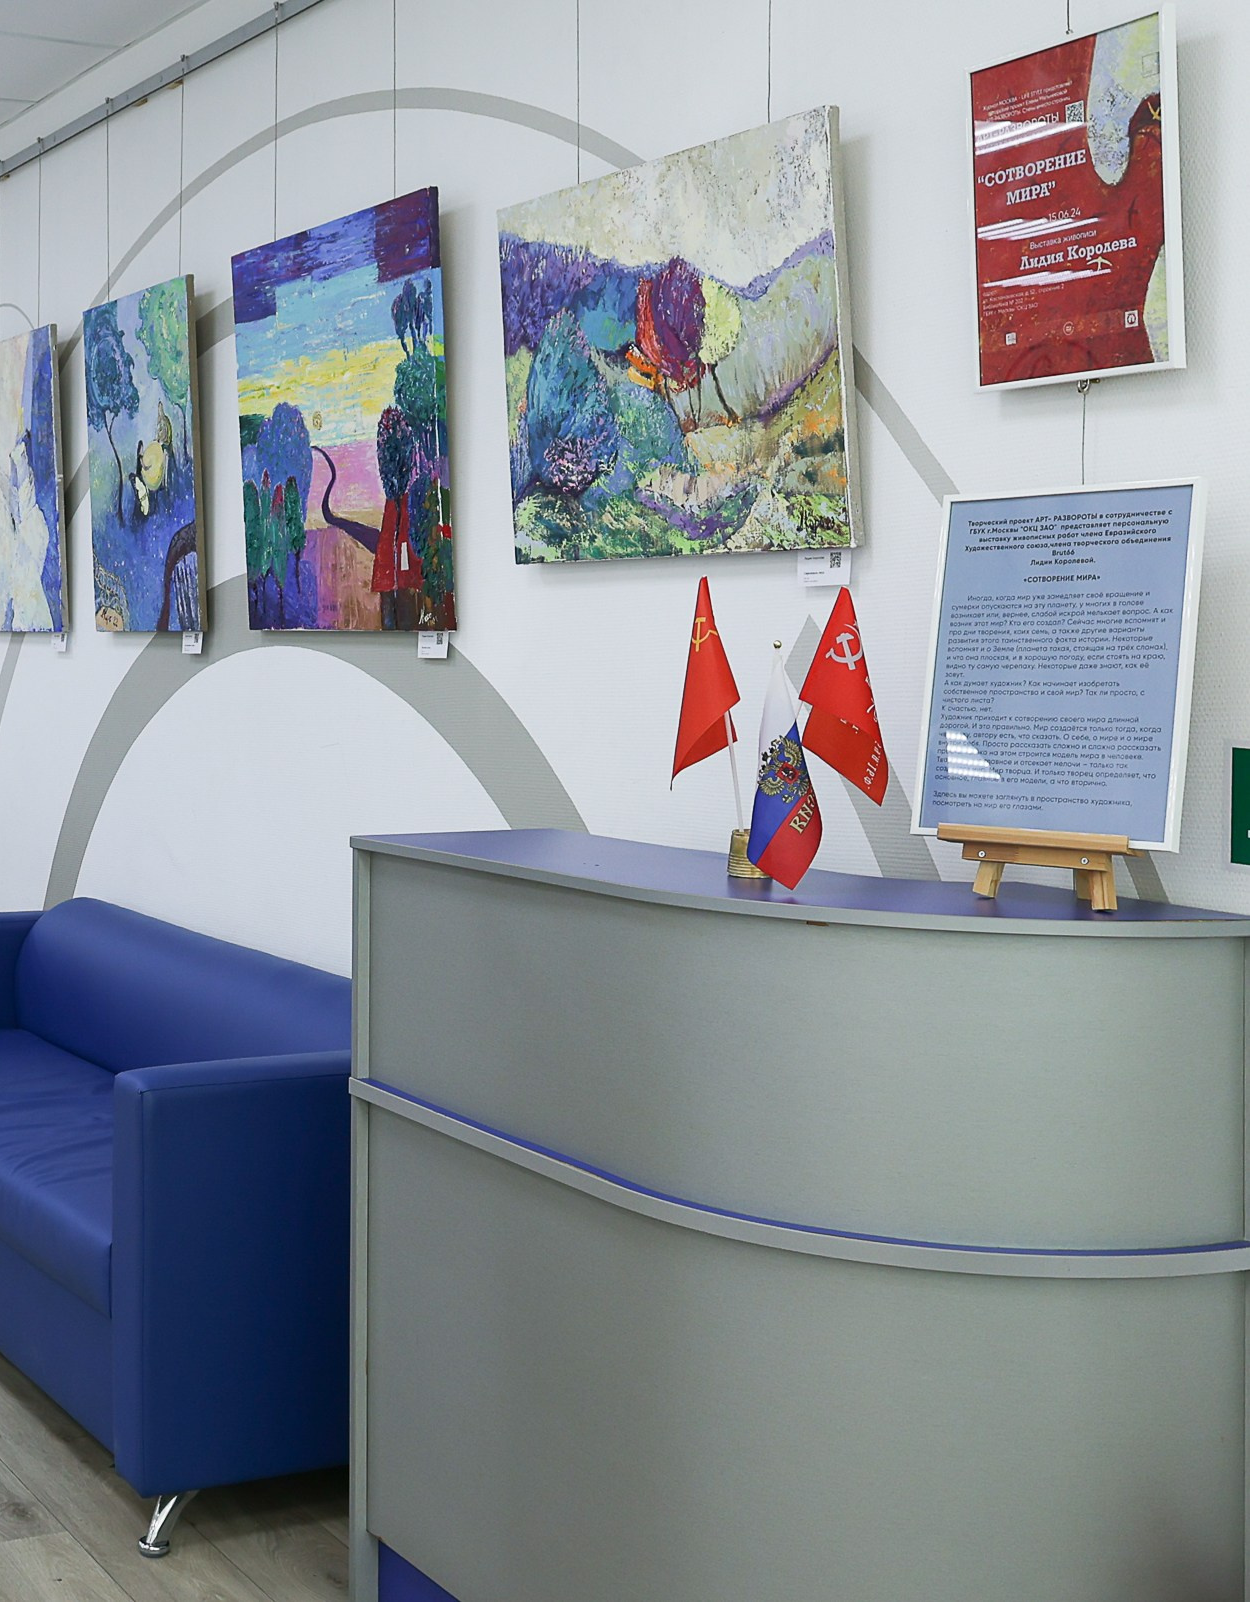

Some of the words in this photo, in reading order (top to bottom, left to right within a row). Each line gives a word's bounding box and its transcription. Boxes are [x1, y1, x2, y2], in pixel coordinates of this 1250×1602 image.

[1049, 208, 1081, 222] 15.06.24
[1030, 237, 1062, 249] Выставка
[1063, 230, 1096, 243] живописи
[1020, 252, 1064, 270] Лидия
[1068, 237, 1137, 260] Королева
[968, 518, 1007, 527] Творческий
[1053, 512, 1097, 521] РАЗВОРОТЫ
[1105, 509, 1166, 519] сотрудничестве
[1060, 522, 1110, 530] представляет
[1112, 518, 1169, 527] персональную
[1057, 531, 1078, 539] работ
[1104, 526, 1156, 536] Евразийского
[964, 543, 1024, 552] Художественного
[1073, 538, 1119, 547] творческого
[1121, 534, 1171, 544] объединения
[1030, 558, 1052, 566] Лидии
